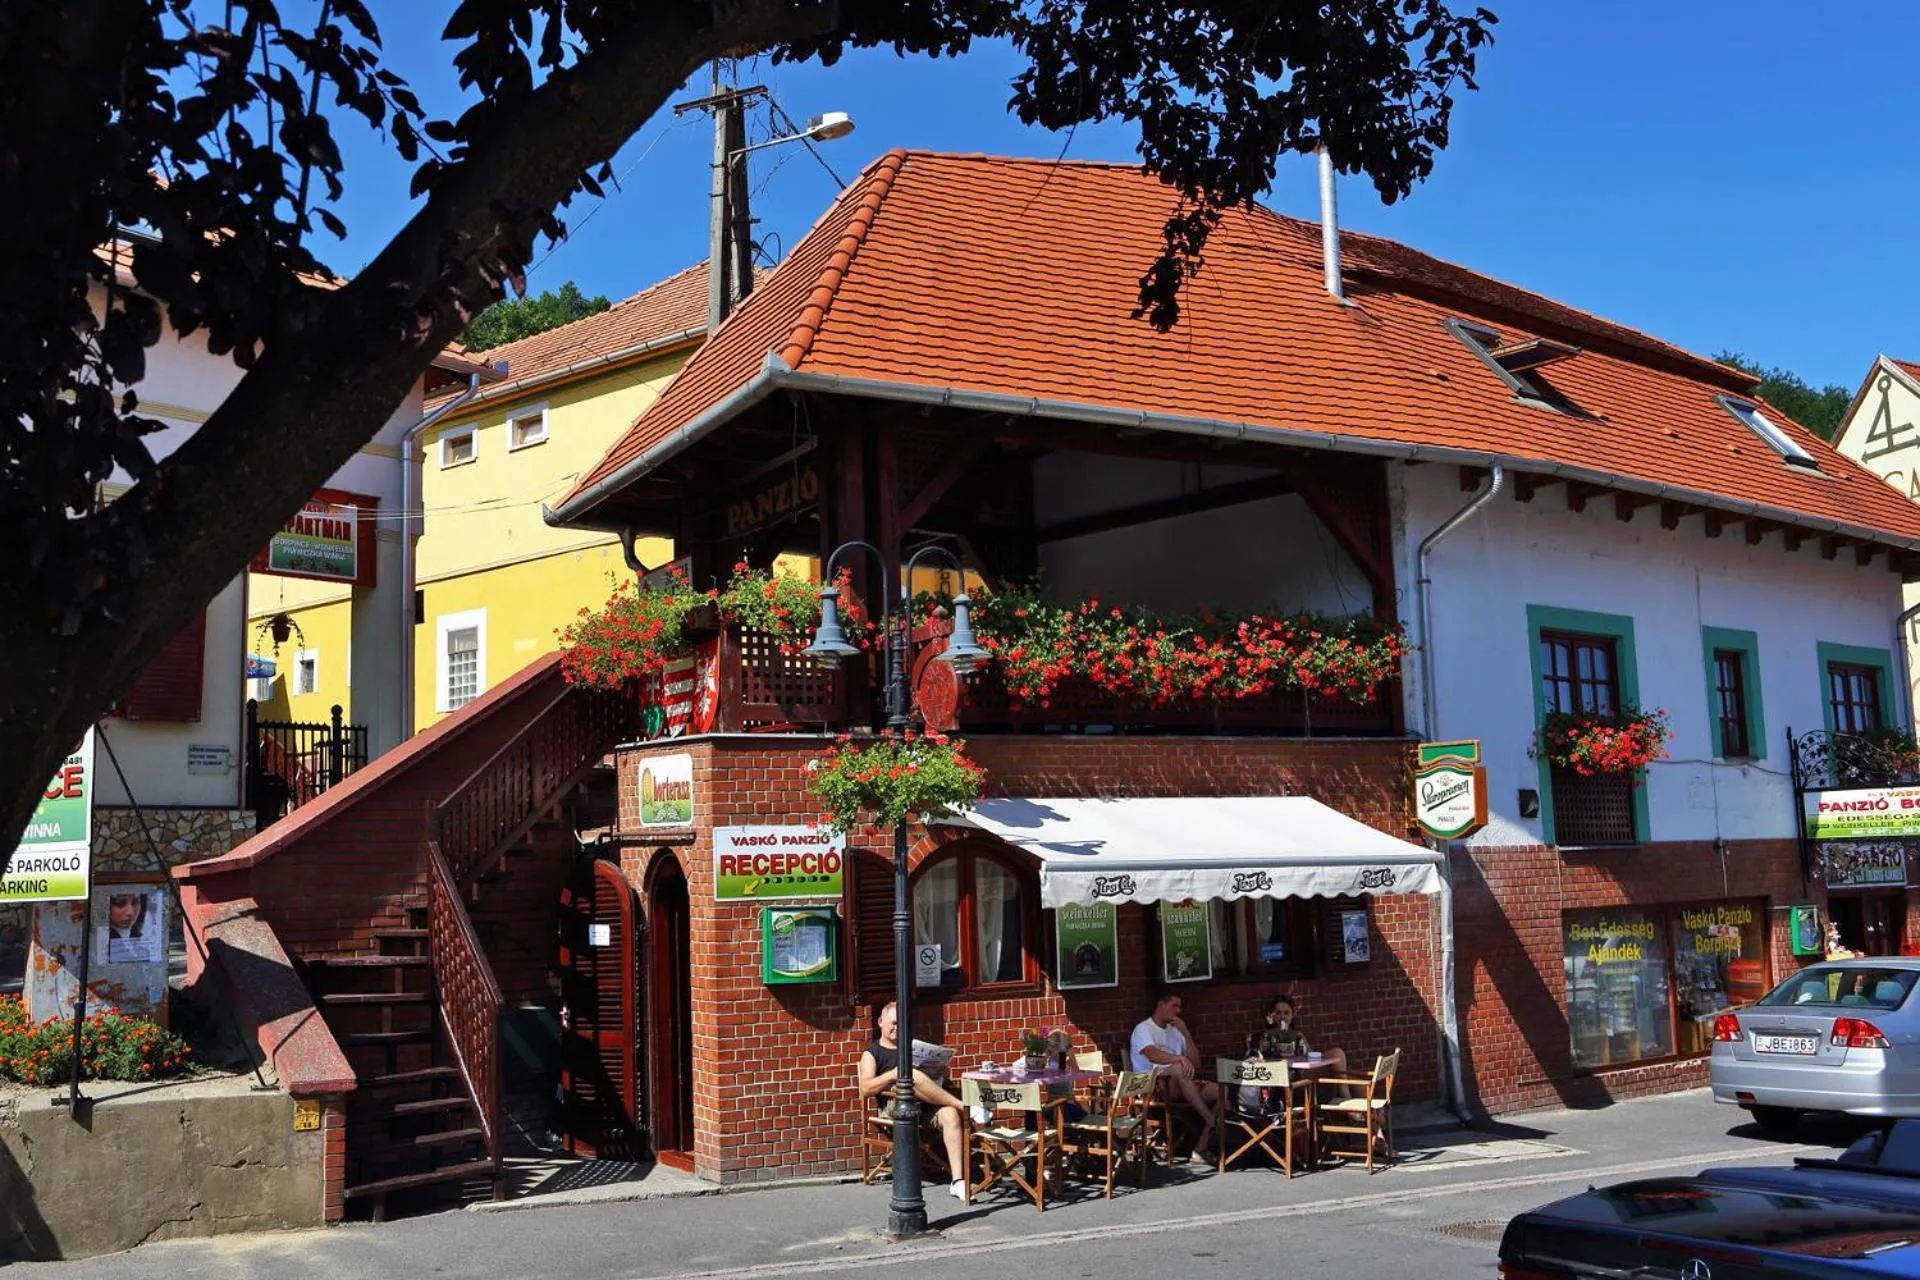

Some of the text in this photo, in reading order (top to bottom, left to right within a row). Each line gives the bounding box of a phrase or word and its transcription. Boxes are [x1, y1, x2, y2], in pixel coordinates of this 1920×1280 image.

[727, 463, 818, 535] PANZIÓ
[284, 514, 351, 541] PARTMAN
[1421, 779, 1471, 807] Staropramen
[1818, 797, 1889, 813] PANZIÓ
[730, 831, 831, 847] VASKÓ PANZIÓ
[17, 853, 81, 874] PARKOLÓ
[720, 846, 841, 877] RECEPCIÓ
[0, 879, 48, 895] ARKING
[1682, 904, 1752, 930] Vaskó Panzió
